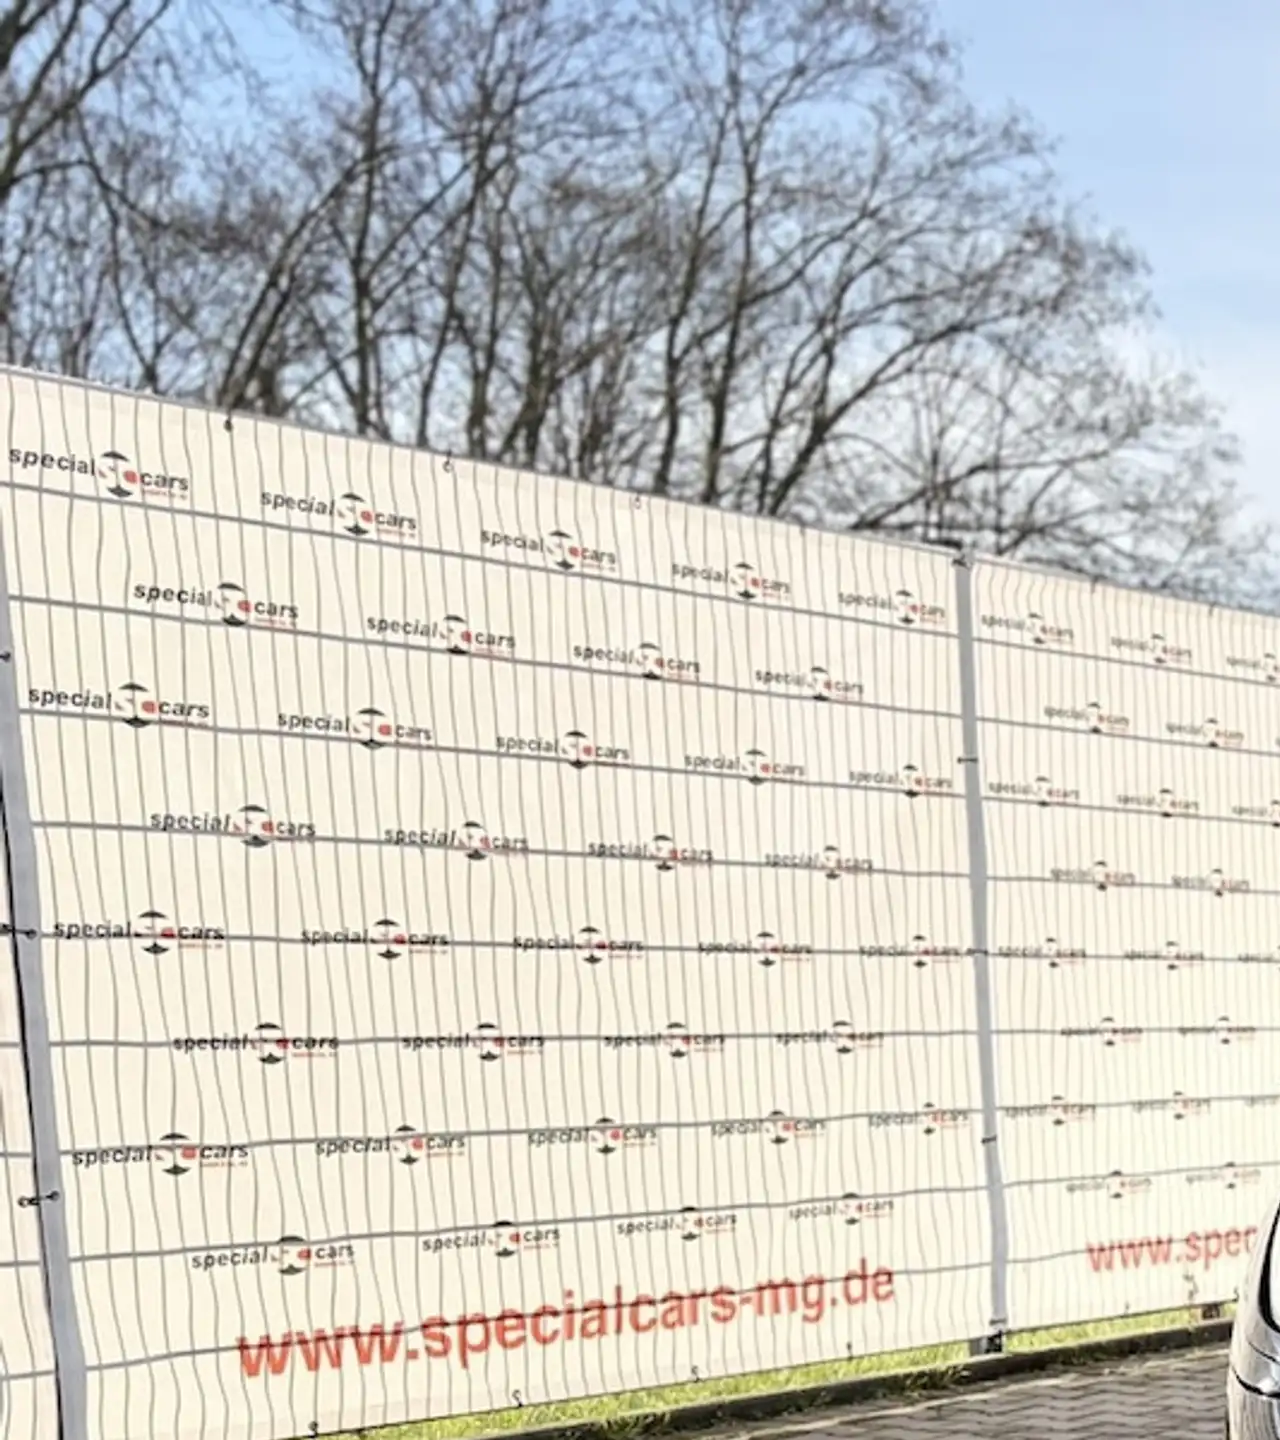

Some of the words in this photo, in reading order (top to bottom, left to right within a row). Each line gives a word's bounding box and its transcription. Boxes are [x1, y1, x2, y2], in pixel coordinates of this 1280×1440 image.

[134, 582, 212, 607] special
[367, 615, 438, 638] special
[28, 688, 112, 709] special
[277, 712, 349, 733] special
[192, 1246, 268, 1271] special
[236, 1257, 895, 1377] www.specialcars-mg.de
